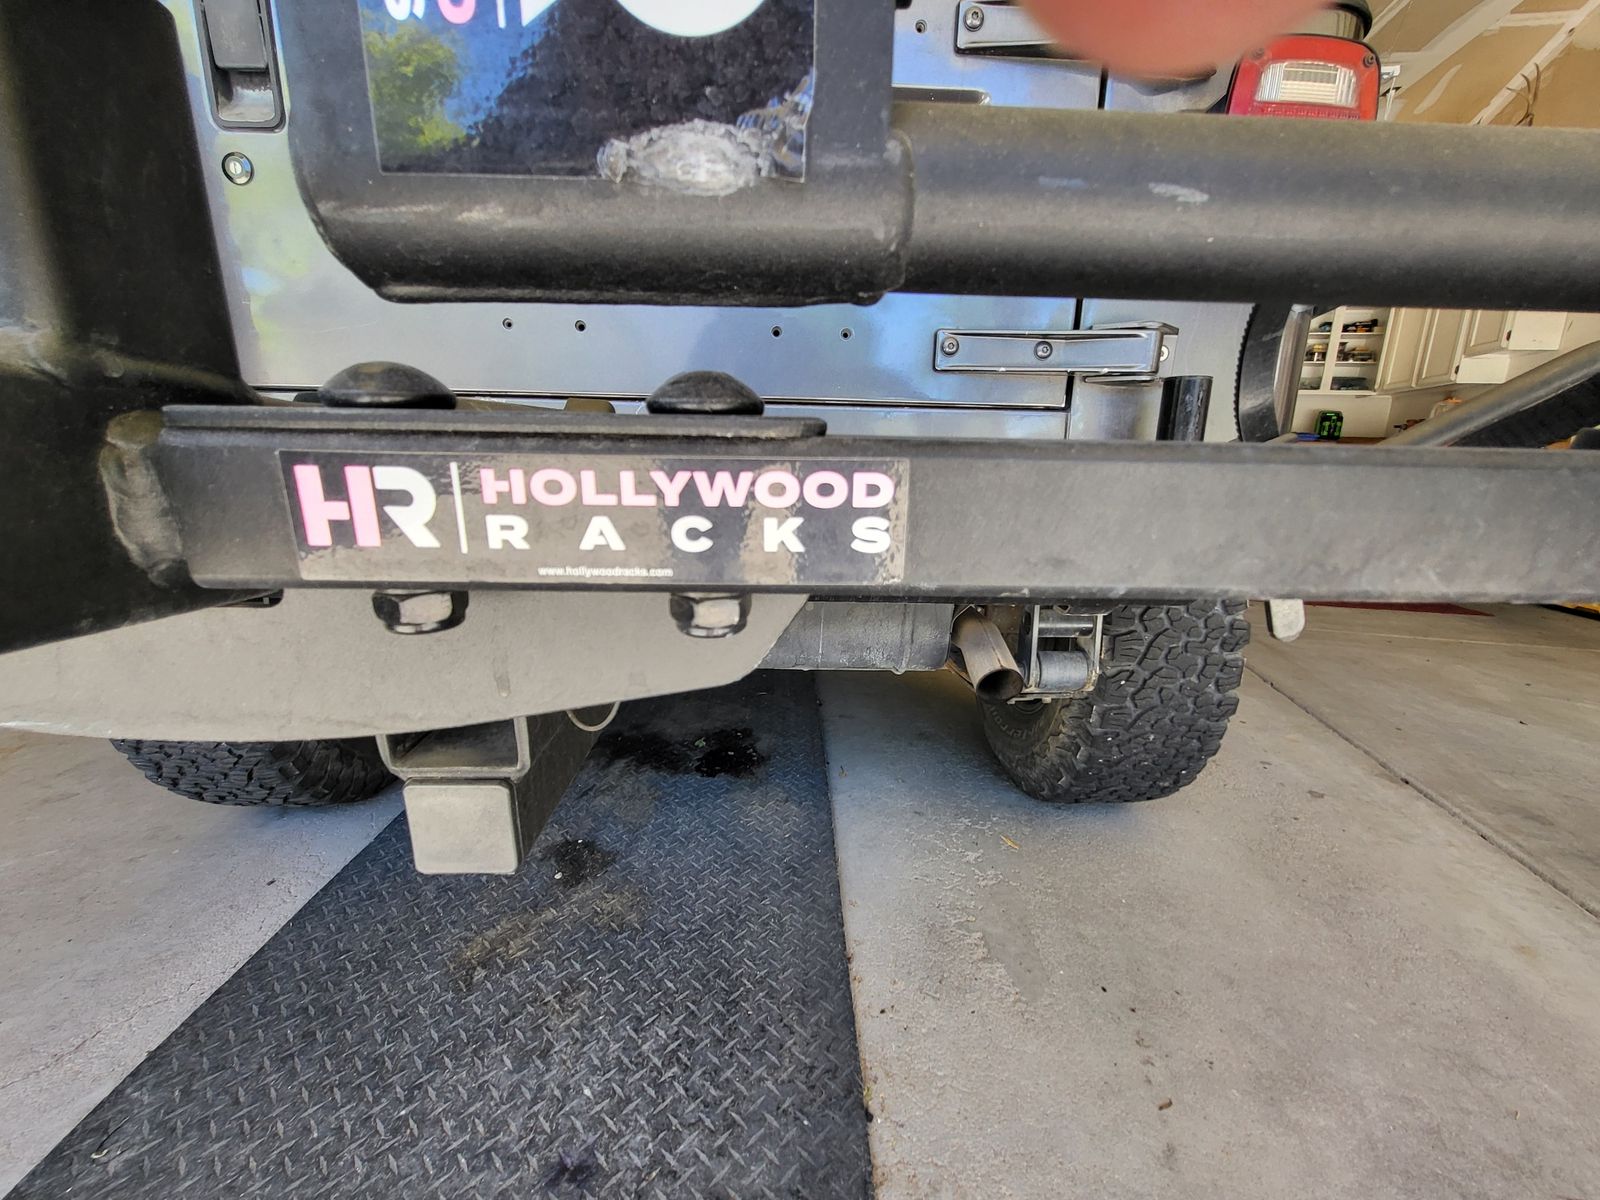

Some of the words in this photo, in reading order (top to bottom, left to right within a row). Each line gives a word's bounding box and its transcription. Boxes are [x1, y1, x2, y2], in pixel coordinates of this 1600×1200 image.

[293, 464, 440, 548] HR
[480, 468, 895, 509] HOLLYWOOD
[485, 514, 893, 554] RACKS
[538, 566, 674, 577] www.hollywoodracks.com
